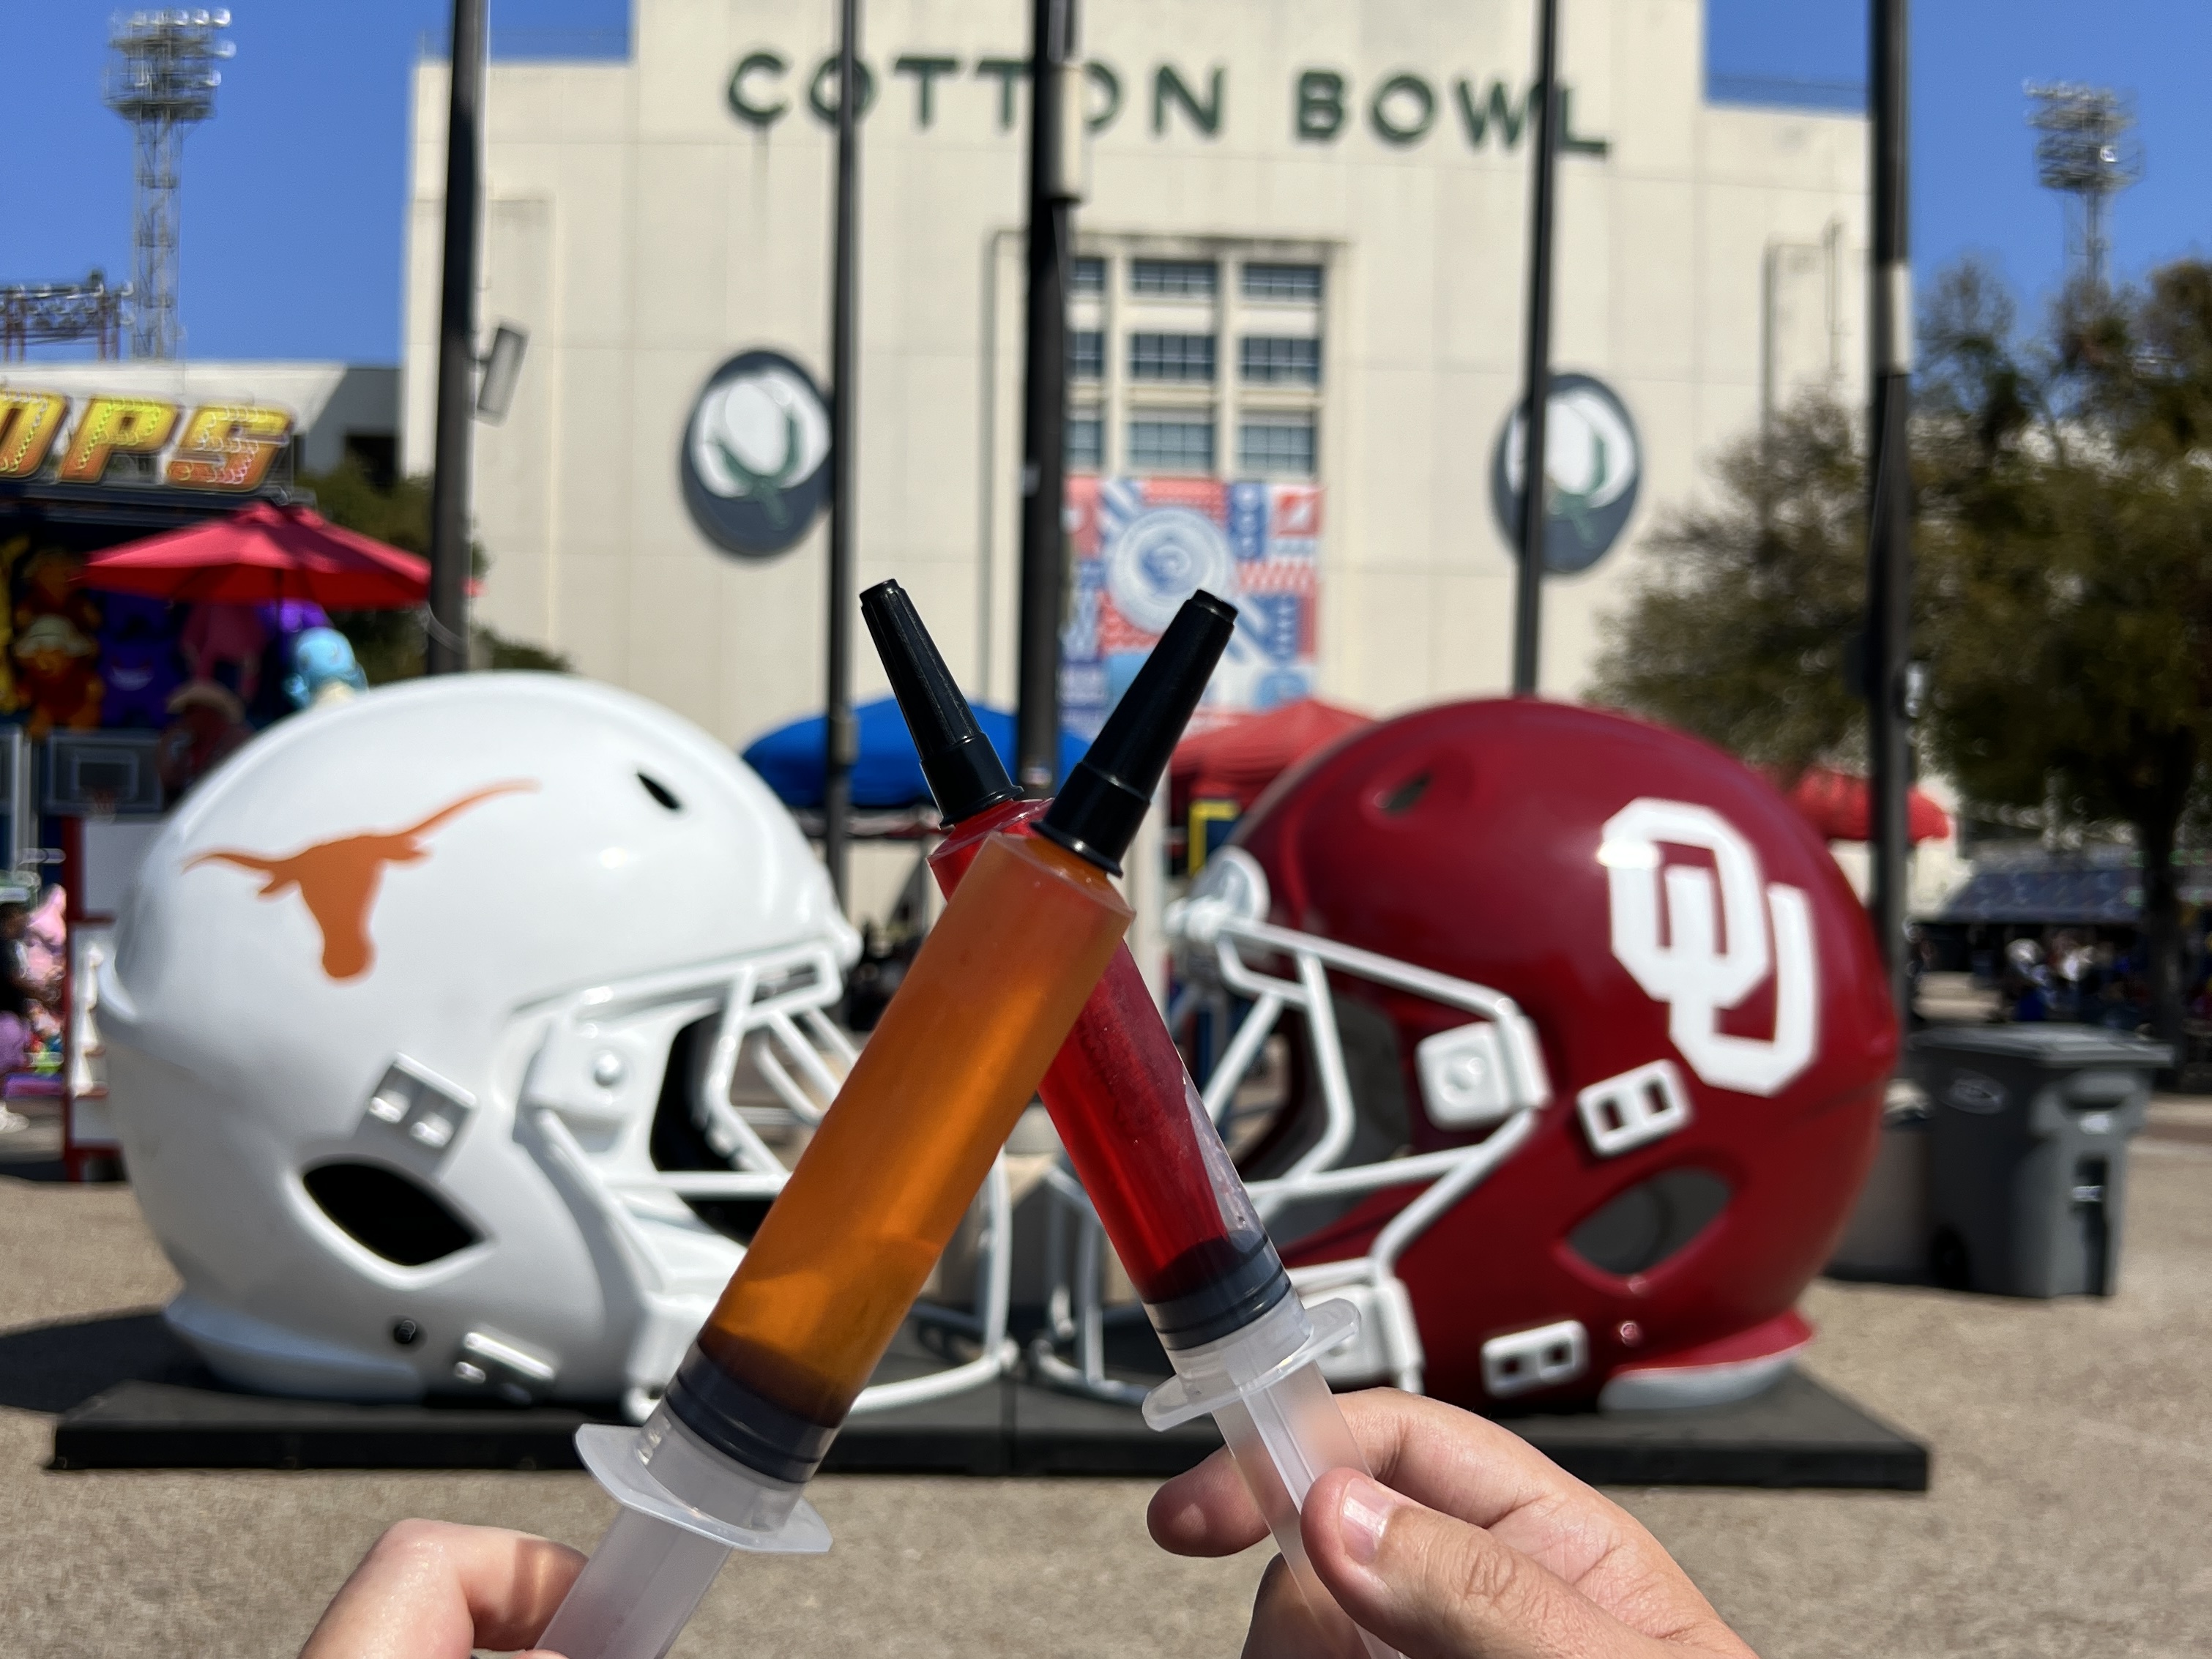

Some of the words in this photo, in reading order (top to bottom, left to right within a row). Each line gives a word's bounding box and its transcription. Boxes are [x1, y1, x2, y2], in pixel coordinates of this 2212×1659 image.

[728, 50, 1227, 136] COTTON
[1296, 69, 1609, 155] BOWL
[1599, 797, 1821, 1097] OU
